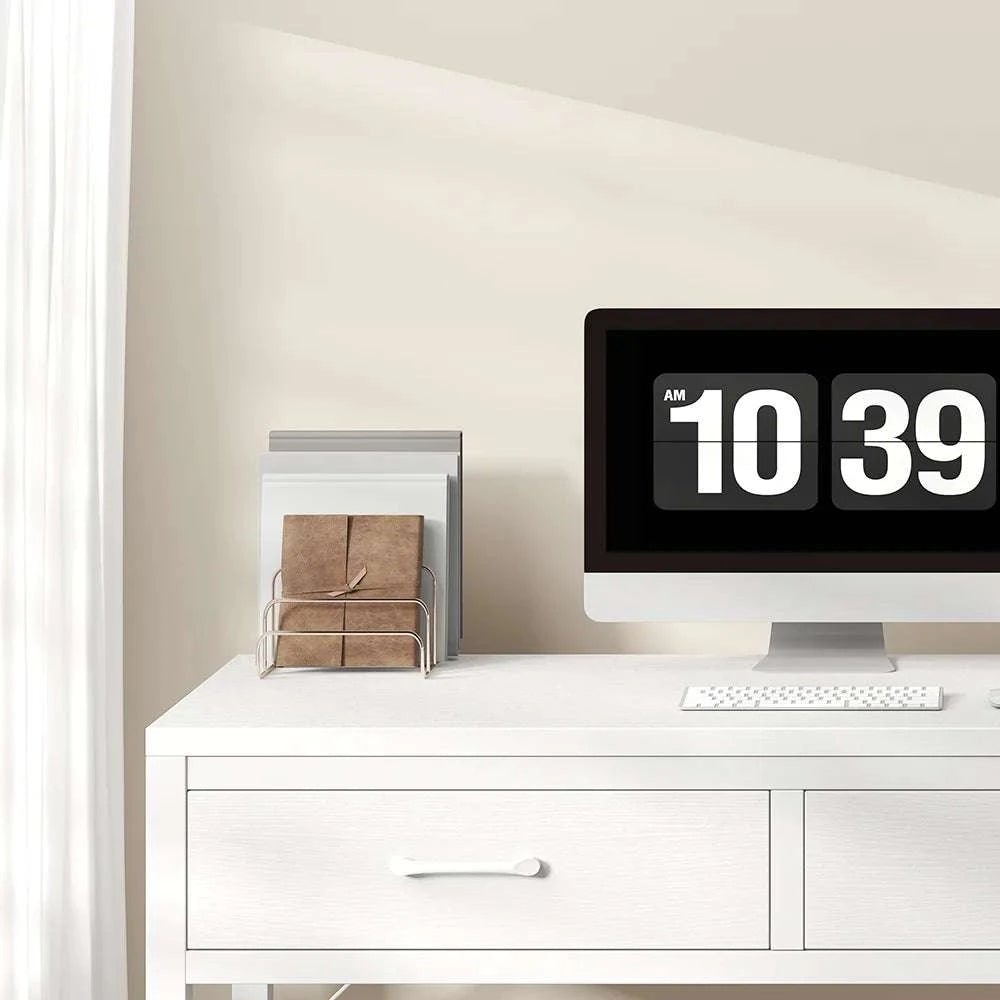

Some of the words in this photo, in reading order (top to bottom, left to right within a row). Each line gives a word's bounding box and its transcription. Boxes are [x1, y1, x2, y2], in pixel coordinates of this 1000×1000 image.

[663, 389, 686, 401] AM
[670, 388, 801, 496] 10
[840, 388, 986, 496] 39
